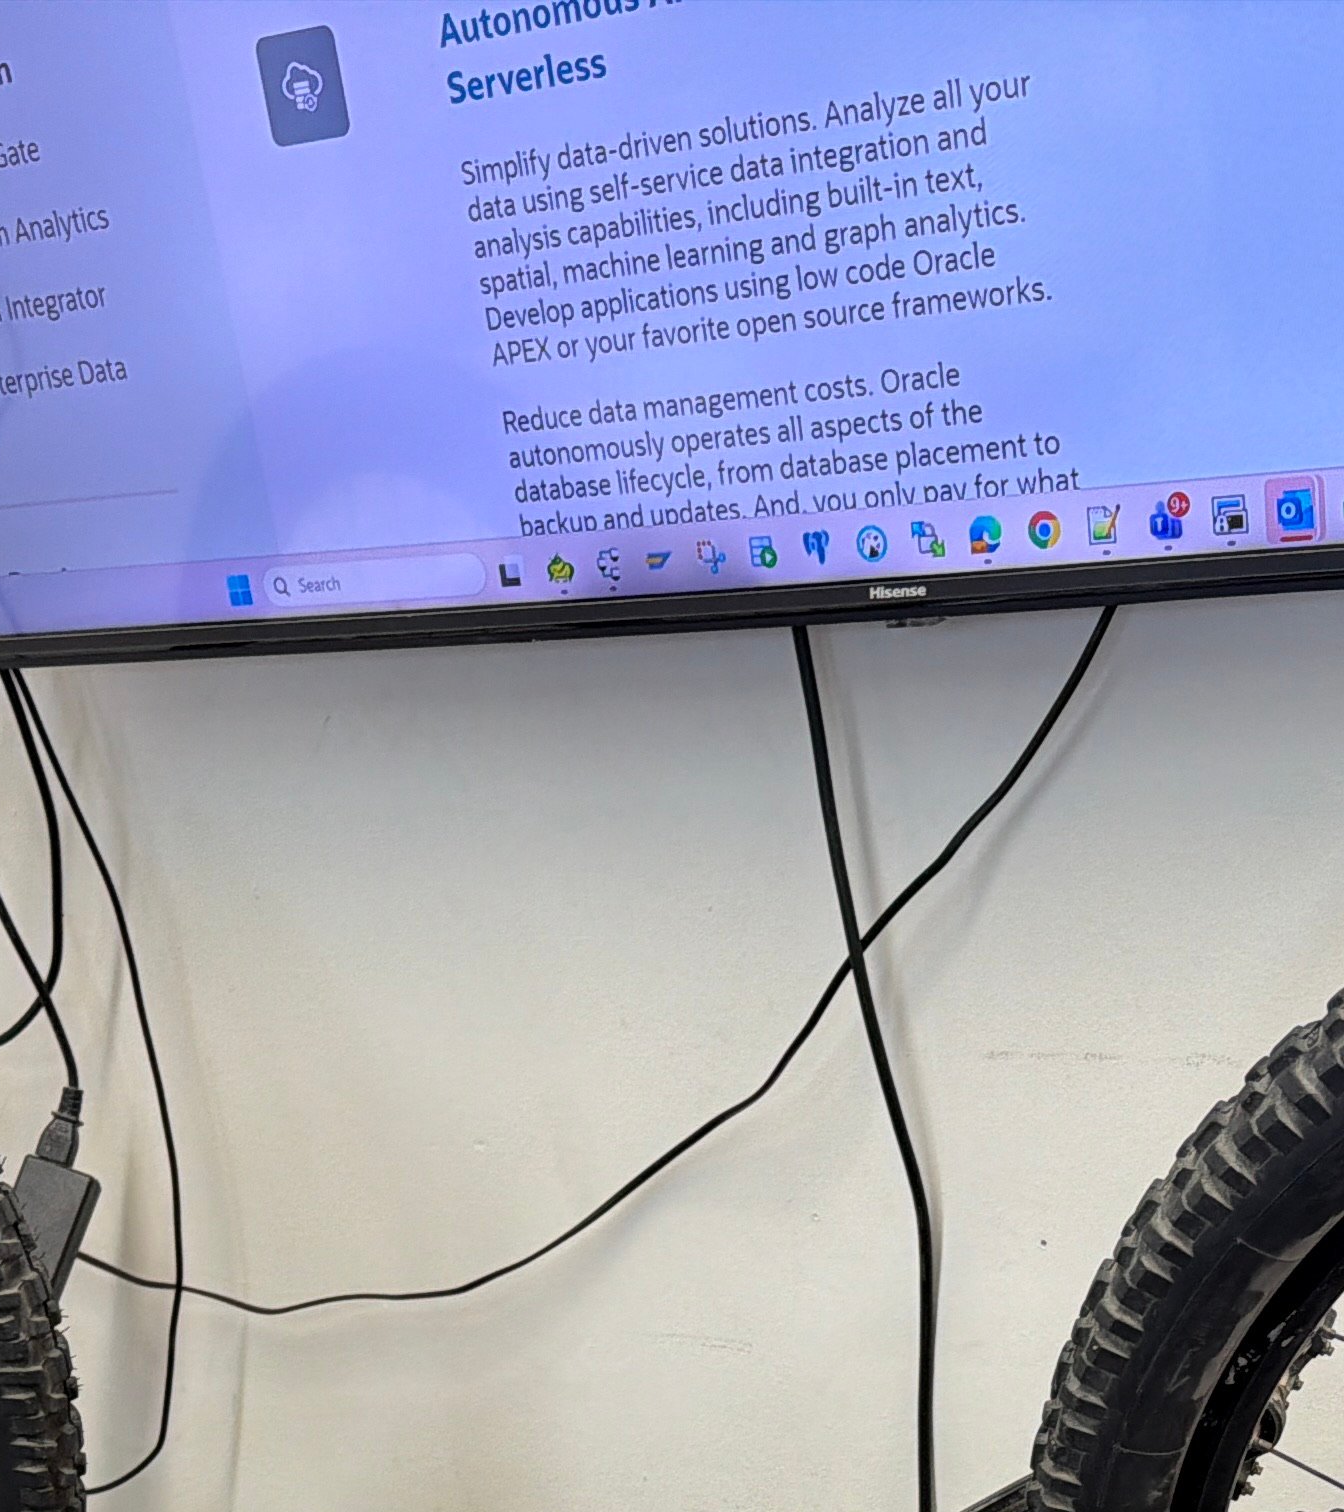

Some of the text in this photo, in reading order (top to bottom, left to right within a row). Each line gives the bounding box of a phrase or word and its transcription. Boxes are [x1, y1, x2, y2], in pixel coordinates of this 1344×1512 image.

[446, 53, 606, 104] Serverless
[460, 74, 1031, 185] Simplify data-driven solutions. Analyze all your
[467, 117, 987, 222] data using self-service data integration and
[15, 206, 110, 243] Analytics
[473, 162, 983, 259] analysis capabilities, including built-in text,
[478, 200, 1025, 299] spatial, machine learning and graph analytics.
[4, 286, 105, 321] Integrator
[484, 241, 995, 331] Develop applications using low code Oracle
[492, 277, 1052, 366] APEX or your favorite open source frameworks.
[76, 358, 128, 385] Data
[501, 360, 960, 434] Reduce data management costs. Oracle
[508, 398, 983, 468] autonomously operates all aspects of the
[513, 431, 1061, 503] database lifecycle, from database placement to
[602, 502, 644, 531] and
[973, 472, 1009, 499] for
[1015, 466, 1081, 495] what
[296, 574, 341, 593] Search
[869, 585, 927, 600] Hisense
